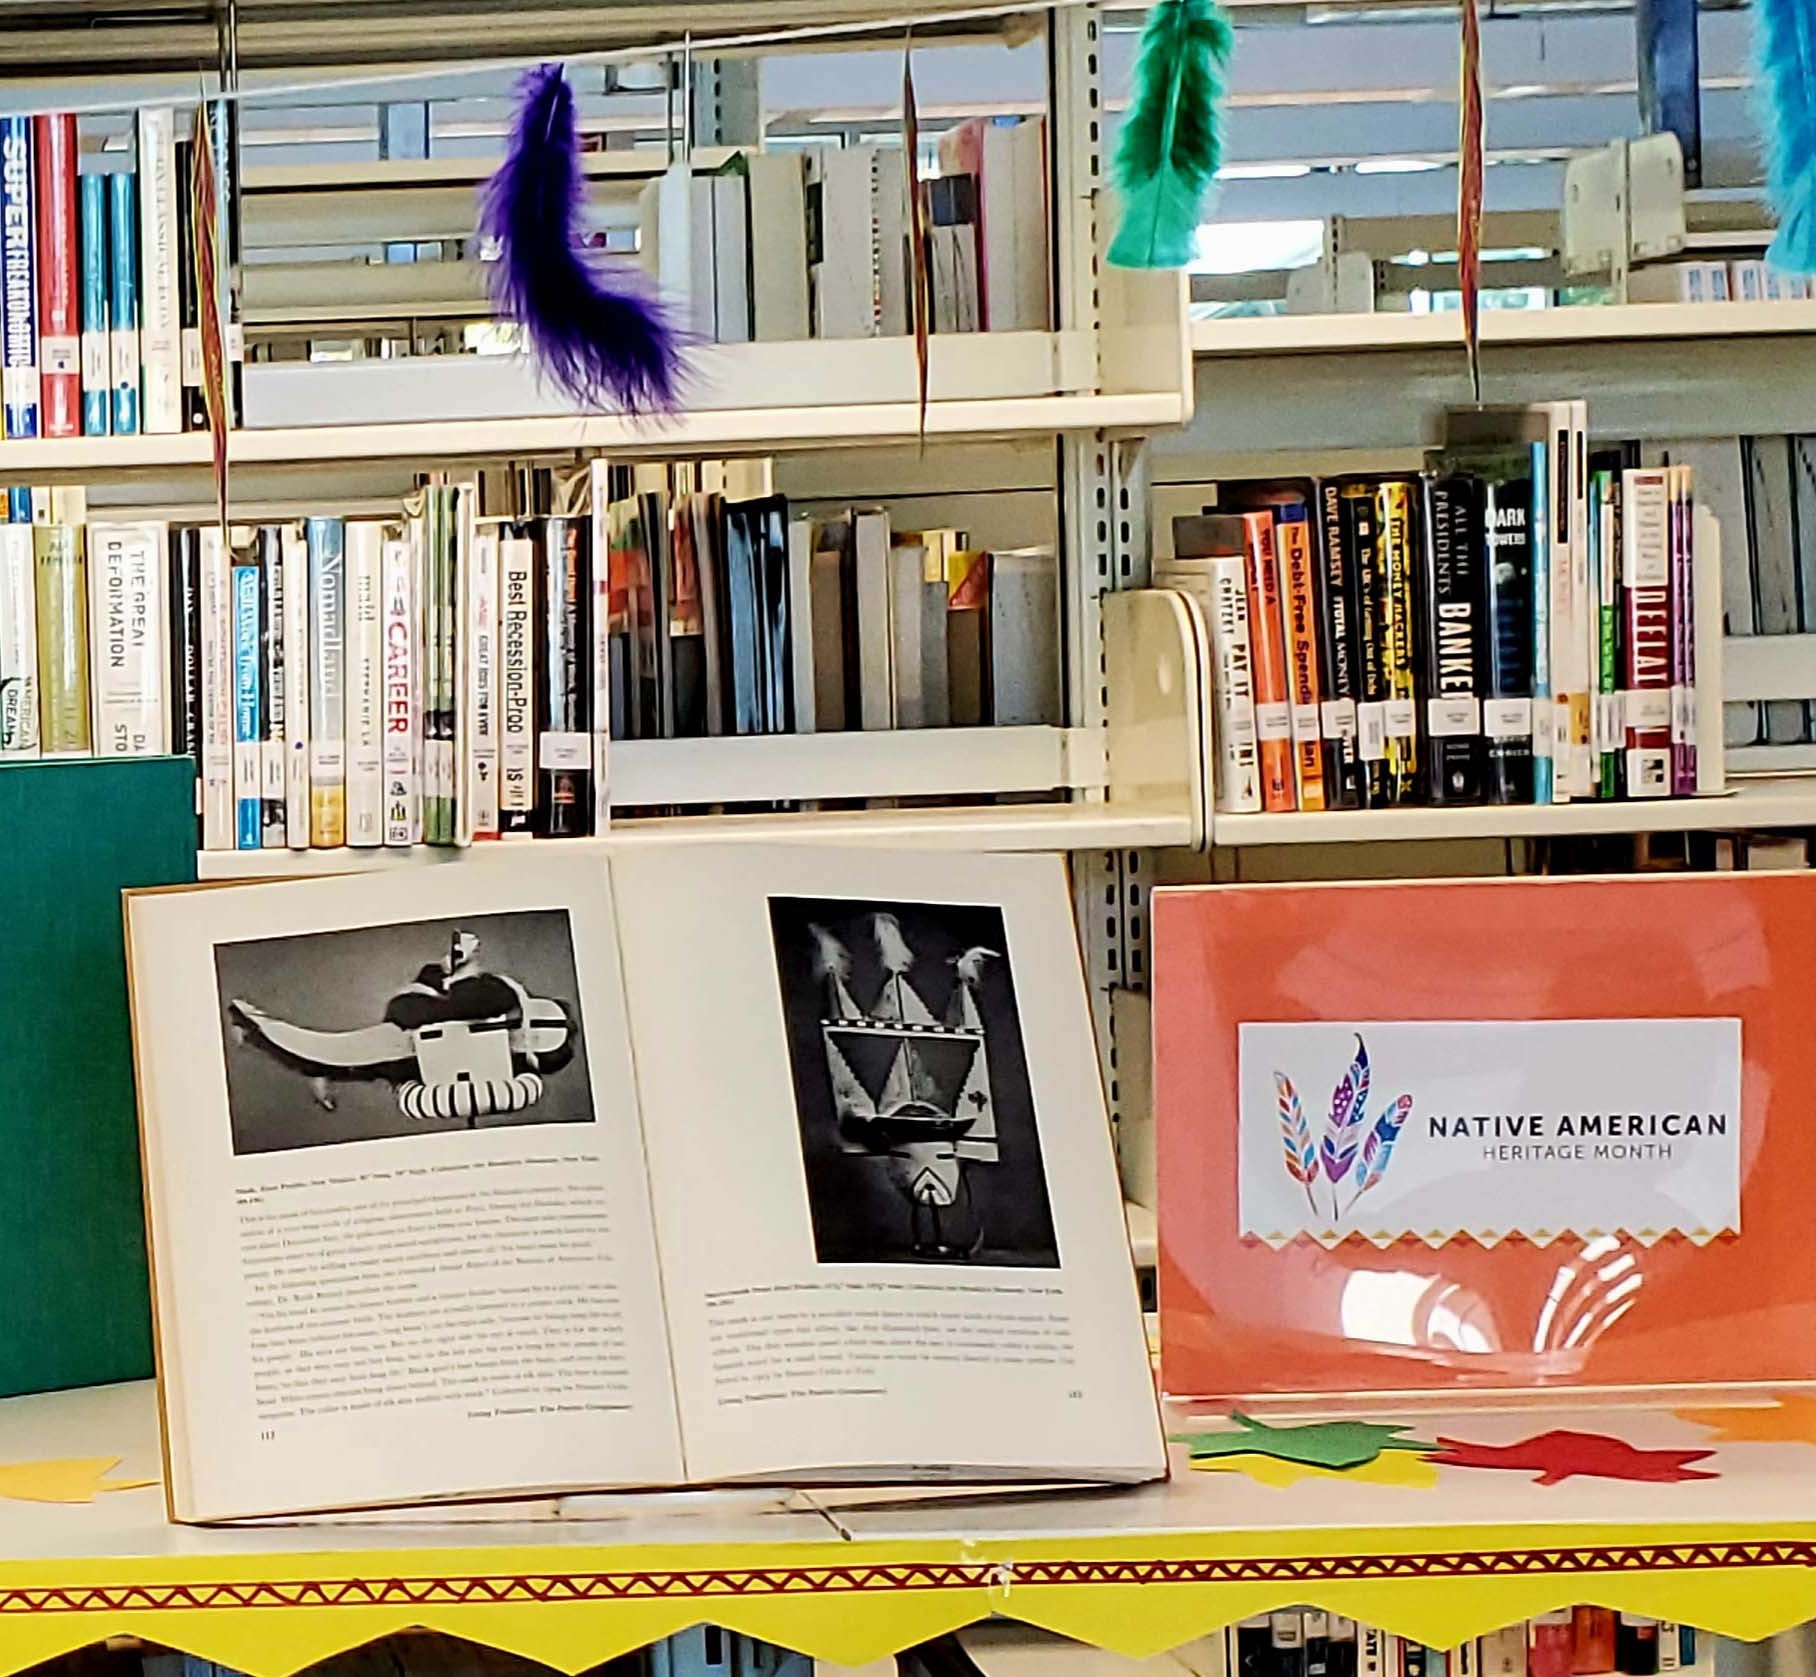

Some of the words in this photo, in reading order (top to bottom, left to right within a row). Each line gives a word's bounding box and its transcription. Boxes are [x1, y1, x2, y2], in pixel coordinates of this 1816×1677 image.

[1, 136, 31, 367] SUPERFREAKONOMIC
[1324, 486, 1341, 522] DAVE
[1453, 505, 1469, 535] ALL
[1484, 508, 1526, 528] DARK
[1389, 519, 1402, 545] THE
[130, 550, 146, 588] THE
[1263, 558, 1275, 592] NEED
[1327, 525, 1344, 588] RAMSEY
[1390, 548, 1404, 599] MONEY
[107, 541, 126, 668] DEFORMATION
[507, 570, 528, 605] Best
[1290, 546, 1308, 634] Debt-Free
[131, 591, 147, 648] GREAT
[1331, 602, 1346, 640] TOTAL
[1392, 603, 1406, 667] HACKERS
[505, 609, 528, 734] Recession-Proo
[1232, 643, 1249, 672] PAY
[1296, 639, 1314, 704] Spendi
[1334, 641, 1350, 694] MONEY
[387, 621, 410, 734] CAREER
[1235, 681, 1250, 698] IT
[186, 712, 198, 756] CRASH
[1303, 740, 1318, 768] lan
[1428, 1114, 1546, 1139] NATIVE
[1555, 1112, 1729, 1137] AMERICAN
[1482, 1143, 1585, 1162] HERITAGE
[1593, 1142, 1673, 1161] MONTH
